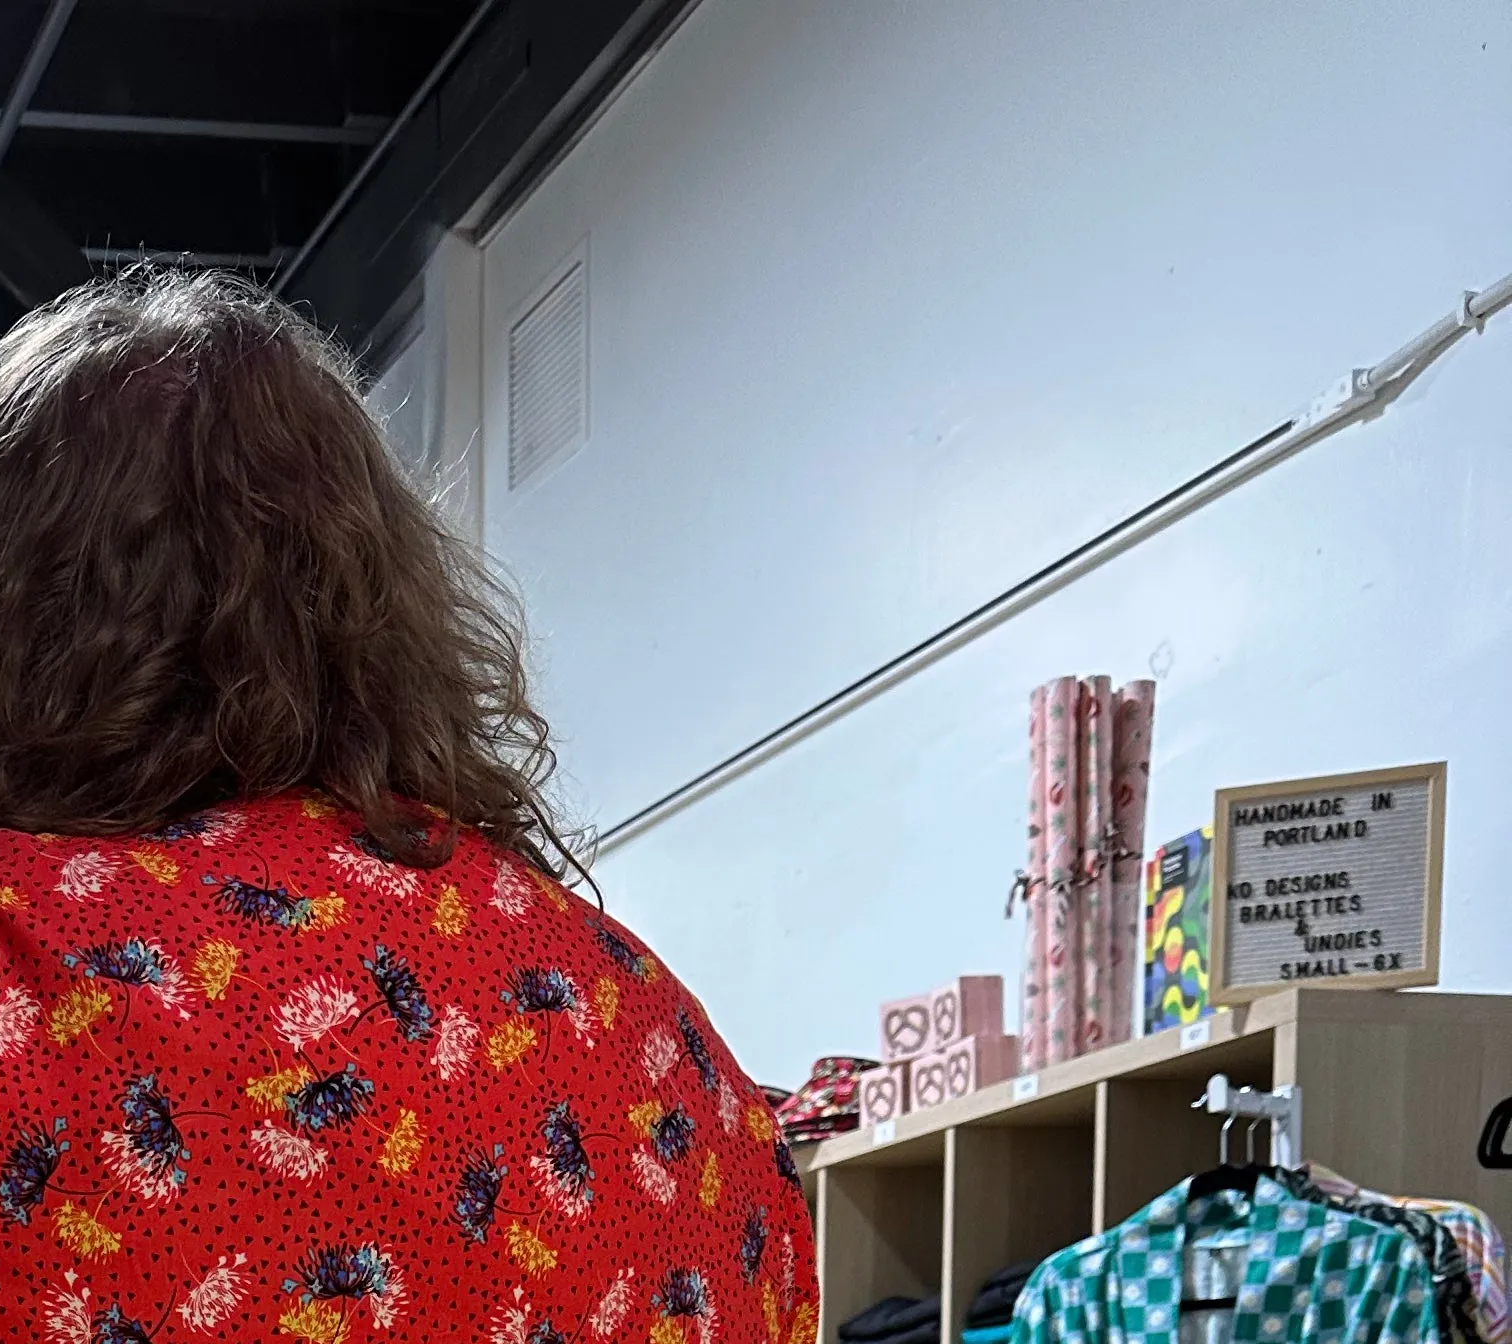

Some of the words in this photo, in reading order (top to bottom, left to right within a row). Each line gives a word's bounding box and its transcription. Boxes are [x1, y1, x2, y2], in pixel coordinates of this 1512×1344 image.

[1234, 797, 1345, 827] HANDMADE
[1371, 792, 1394, 812] IN
[1263, 819, 1369, 848] PORTLAND
[1265, 871, 1350, 897] DESIGNS
[1240, 894, 1362, 924] BRALETTES
[1294, 918, 1309, 937] &
[1304, 929, 1382, 954] UNDIES
